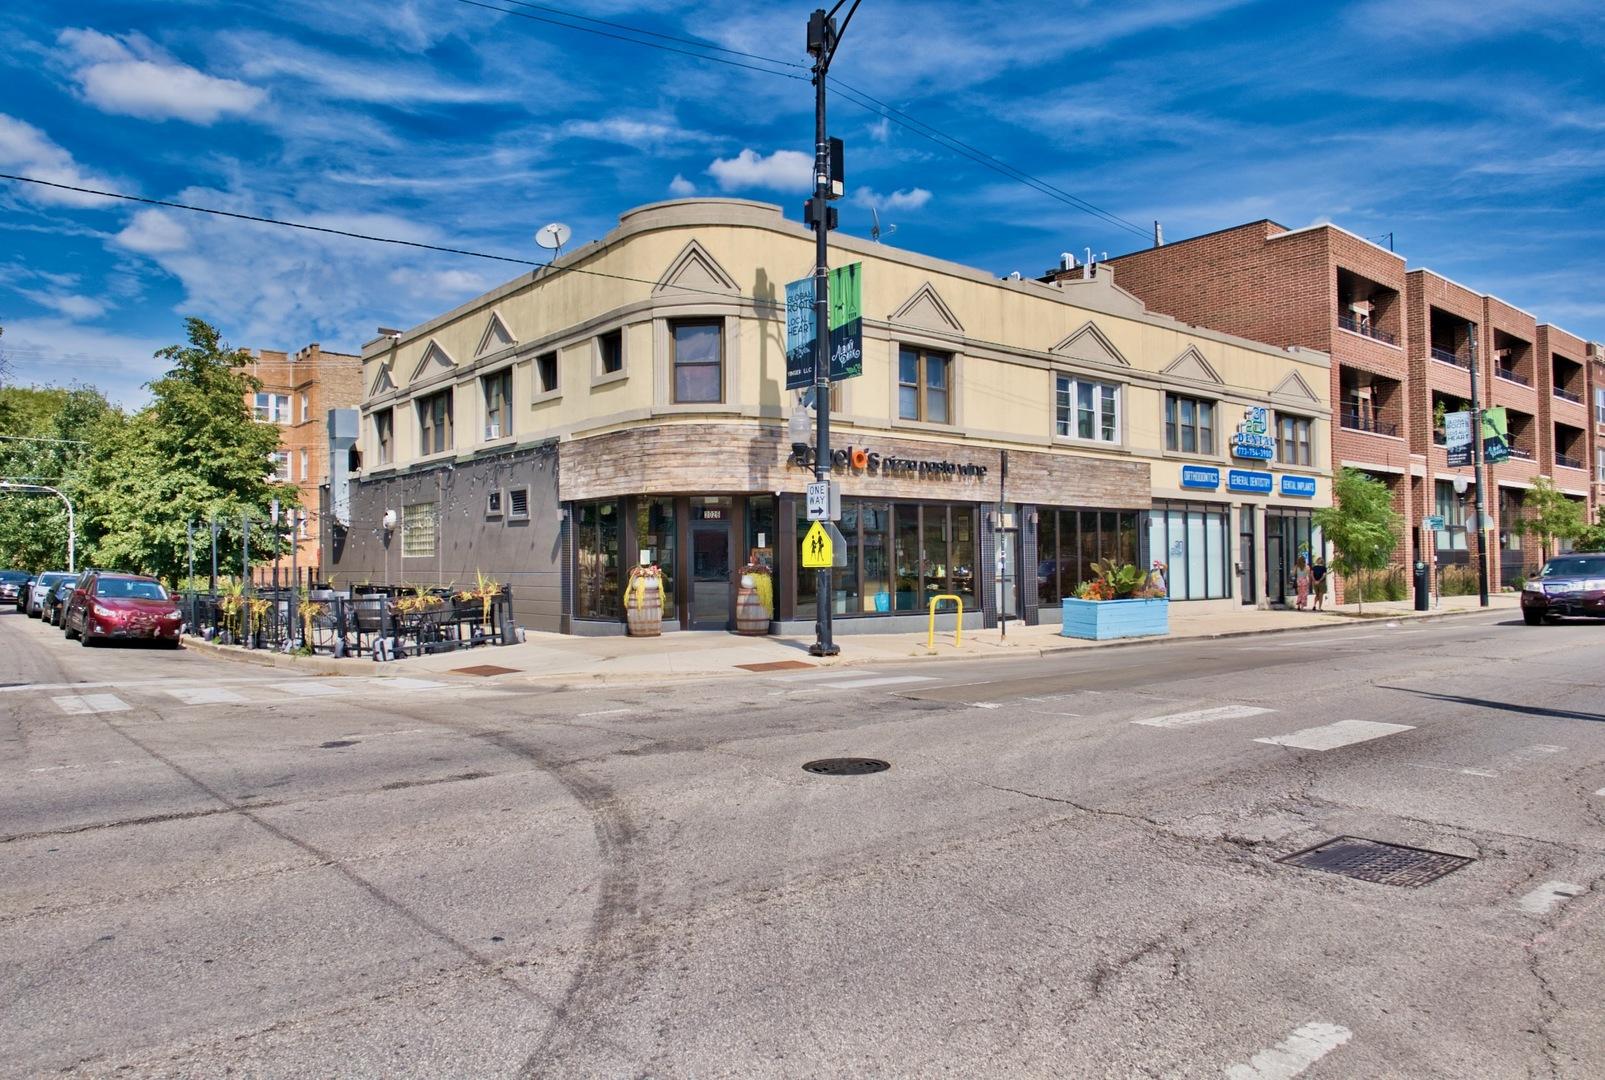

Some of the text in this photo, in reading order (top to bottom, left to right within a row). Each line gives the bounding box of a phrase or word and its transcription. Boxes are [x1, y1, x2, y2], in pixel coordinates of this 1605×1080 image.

[787, 291, 813, 304] GLOBAL
[787, 299, 815, 313] ROOTS
[788, 315, 808, 327] LOCAL
[788, 322, 814, 336] HEART
[1238, 432, 1275, 447] DENTAL
[882, 456, 918, 472] pizza
[919, 460, 956, 475] pasta
[957, 462, 988, 477] wine
[1184, 470, 1218, 483] ORTHODONTICS
[1231, 475, 1271, 488] GENERAL DENTISTRY
[810, 485, 825, 495] ONE
[1283, 480, 1314, 492] DENTAL IMPLANTS
[810, 495, 825, 505] WAY
